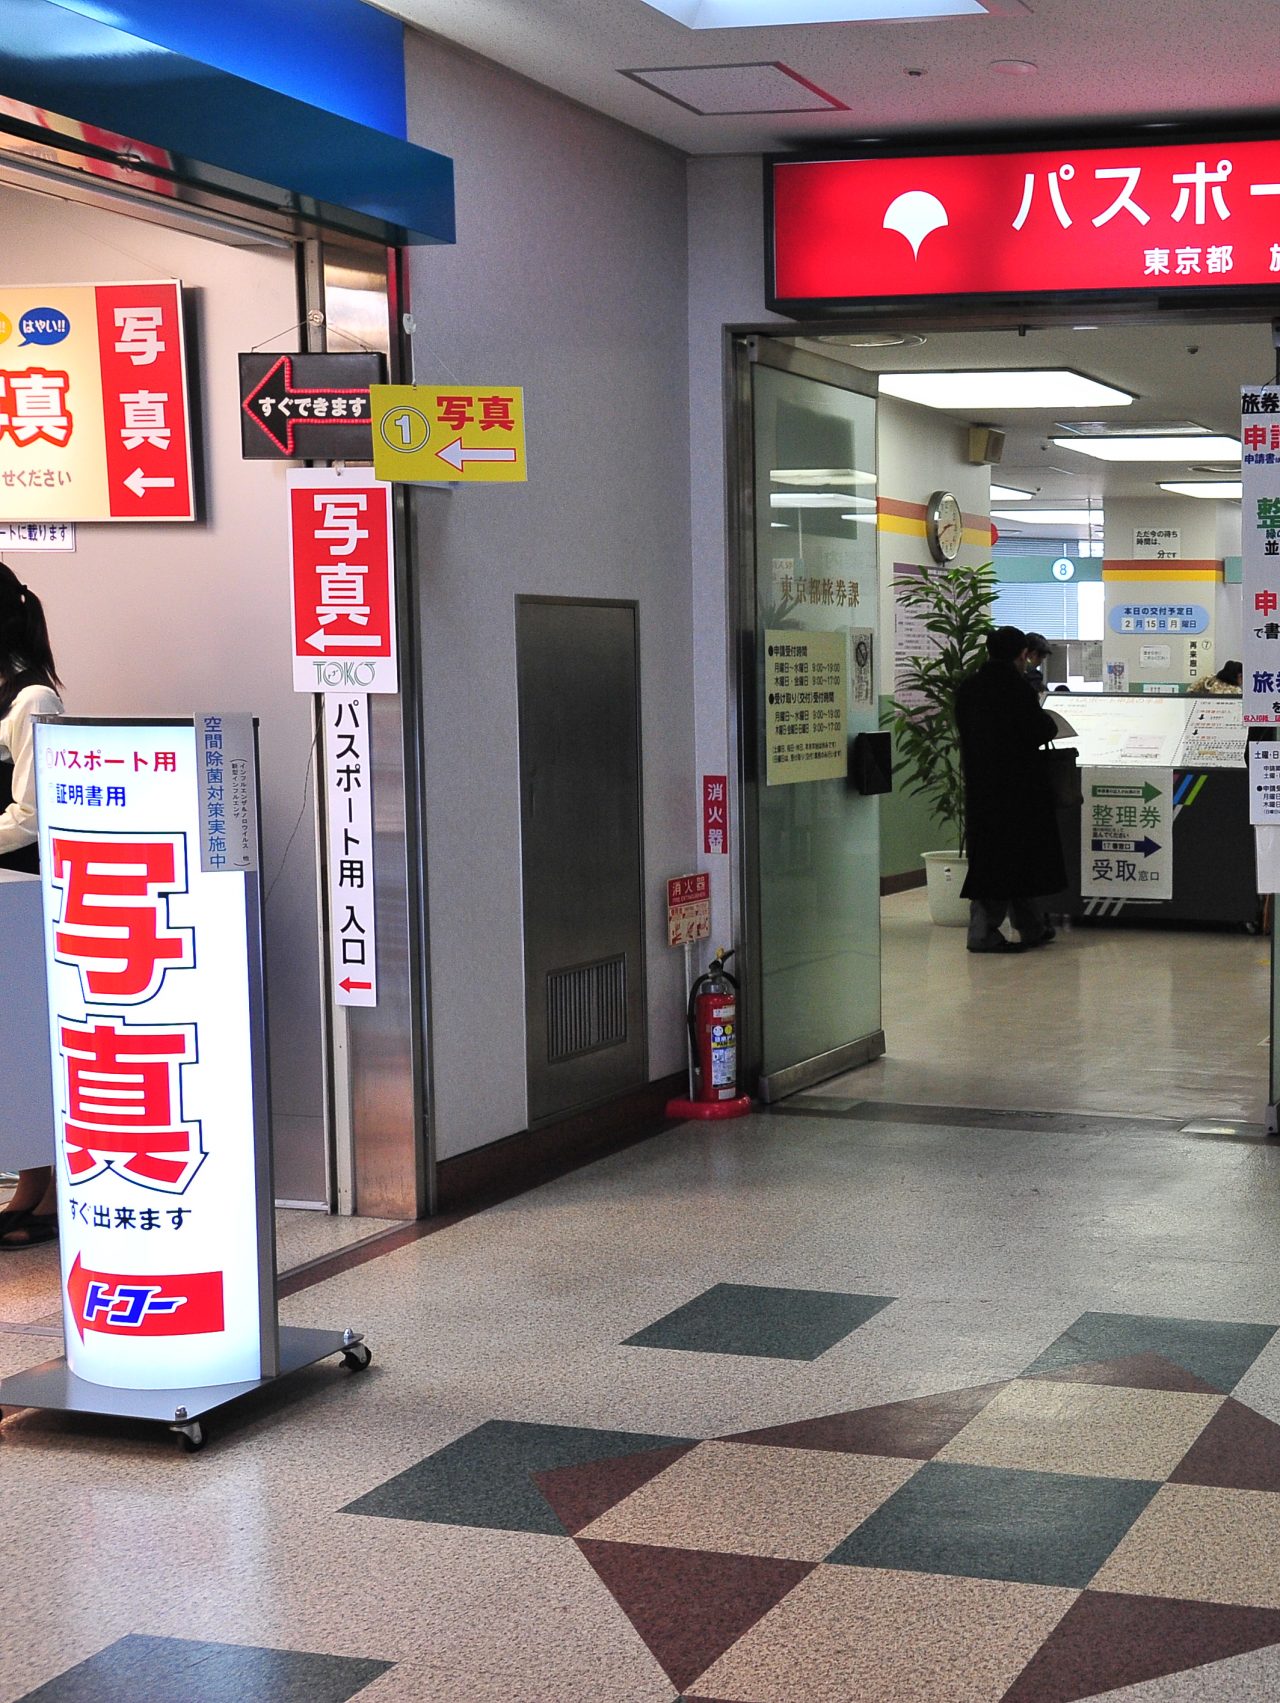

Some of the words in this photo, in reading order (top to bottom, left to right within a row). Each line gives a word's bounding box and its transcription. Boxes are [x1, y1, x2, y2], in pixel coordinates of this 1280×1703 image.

[1142, 245, 1234, 277] 東京都
[112, 306, 172, 451] 写真
[0, 372, 70, 442] 真
[259, 396, 367, 418] すぐできます
[436, 395, 516, 433] 写真
[312, 493, 371, 627] 写真
[1059, 563, 1068, 576] 8
[779, 574, 861, 608] 東京都旅券課
[1124, 607, 1194, 616] 本日の交付予定日
[53, 749, 177, 773] パスポート用
[55, 782, 127, 808] 証明書用
[203, 716, 227, 870] 空間除菌対策実施中
[333, 698, 365, 889] パスポート用
[707, 783, 725, 851] 消火器
[1091, 803, 1162, 829] 整理券
[672, 876, 706, 897] 消火器
[1092, 859, 1160, 882] 受取窓口
[339, 904, 366, 966] 入口
[50, 837, 190, 1186] 写真
[69, 1197, 193, 1232] すぐ出来ます
